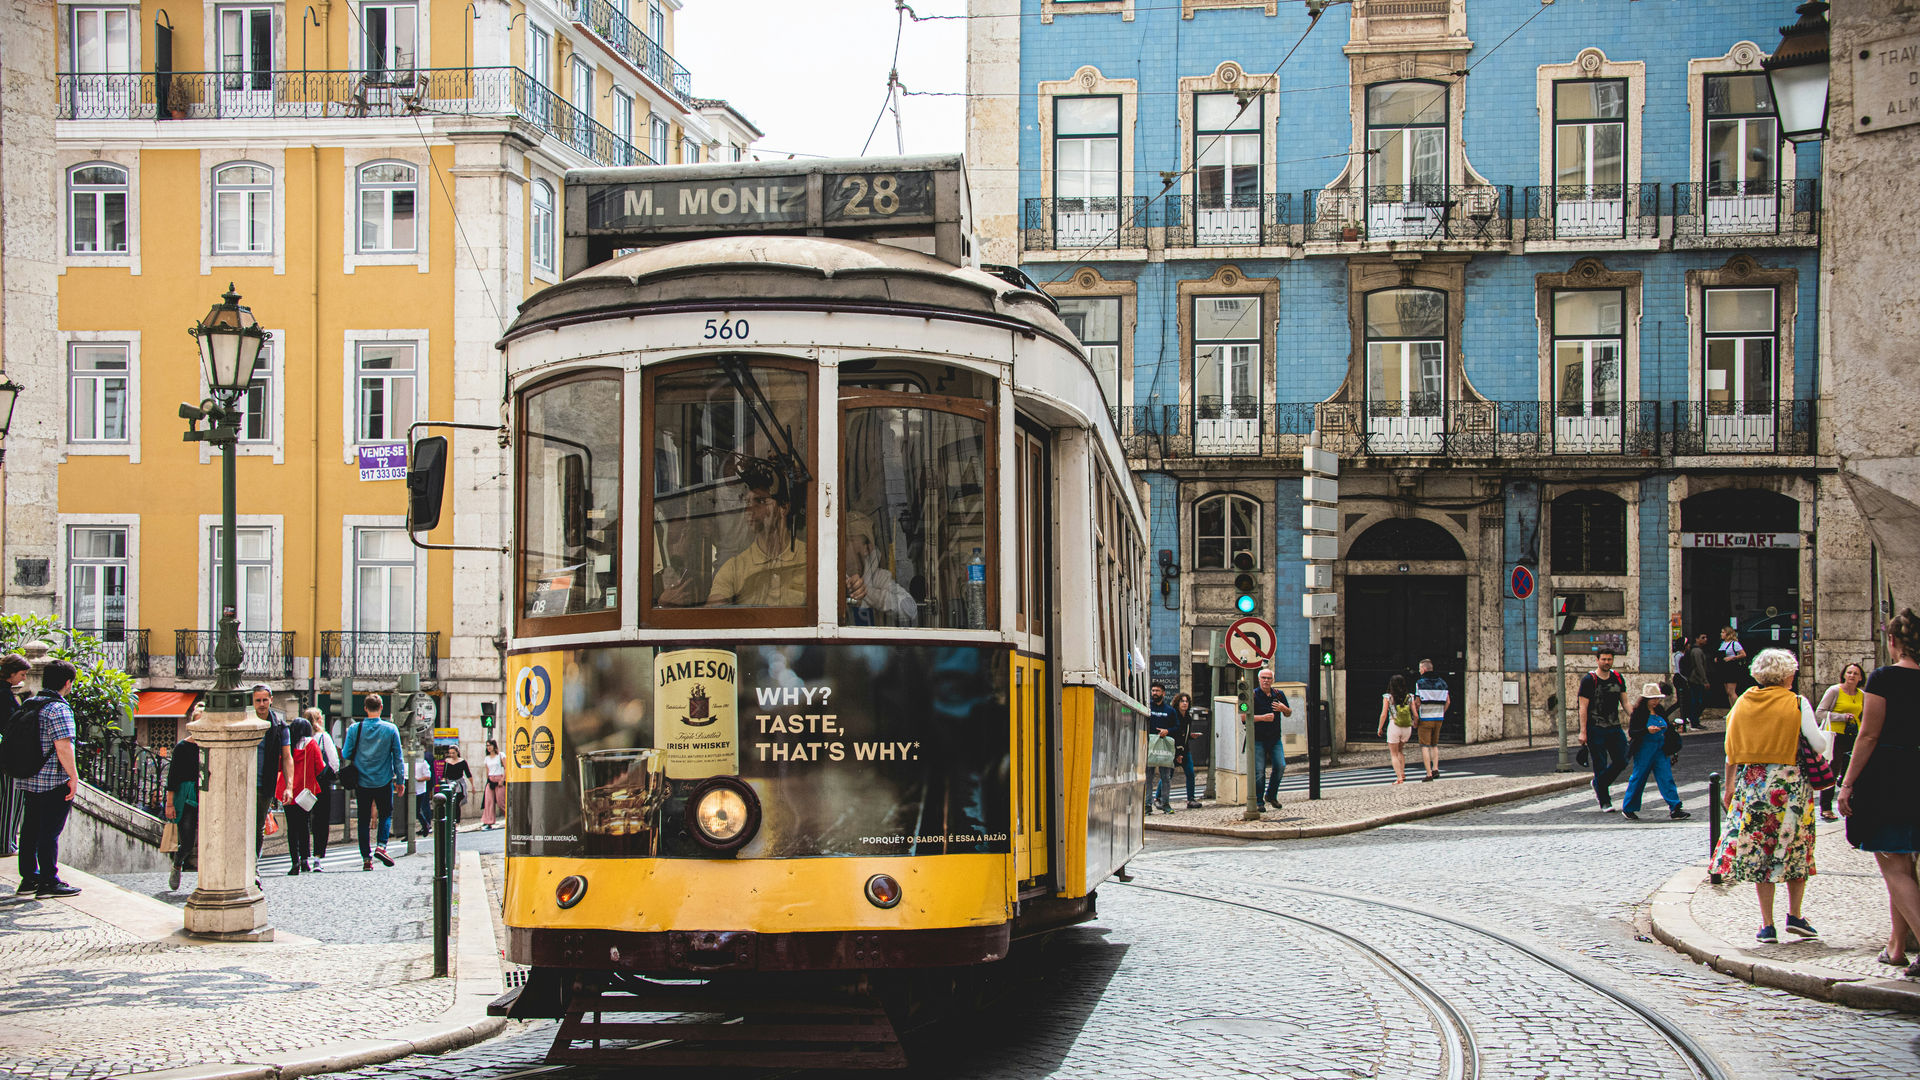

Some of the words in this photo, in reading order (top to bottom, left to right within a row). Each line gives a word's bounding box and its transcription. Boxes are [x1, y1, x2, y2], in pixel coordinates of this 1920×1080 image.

[624, 189, 664, 216] M.
[679, 186, 806, 215] MONIZ
[841, 175, 899, 216] 28
[704, 319, 749, 339] 560
[361, 446, 404, 458] VENDE-SE
[377, 457, 389, 468] T2
[361, 470, 375, 479] 917
[376, 469, 390, 478] 333
[391, 468, 406, 478] 035
[1694, 534, 1734, 547] FOLK
[1747, 534, 1776, 547] ART
[537, 582, 551, 592] 28E
[532, 600, 546, 613] 08
[660, 660, 735, 687] JAMESON
[756, 687, 832, 706] WHY?
[756, 715, 845, 737] TASTE,
[692, 741, 730, 749] WHISKEY
[756, 742, 845, 761] THAT'S
[907, 836, 914, 844] O
[948, 833, 954, 842] É
[956, 834, 974, 842] ESSA
[976, 834, 982, 842] A
[984, 832, 1007, 841] RAZÃO
